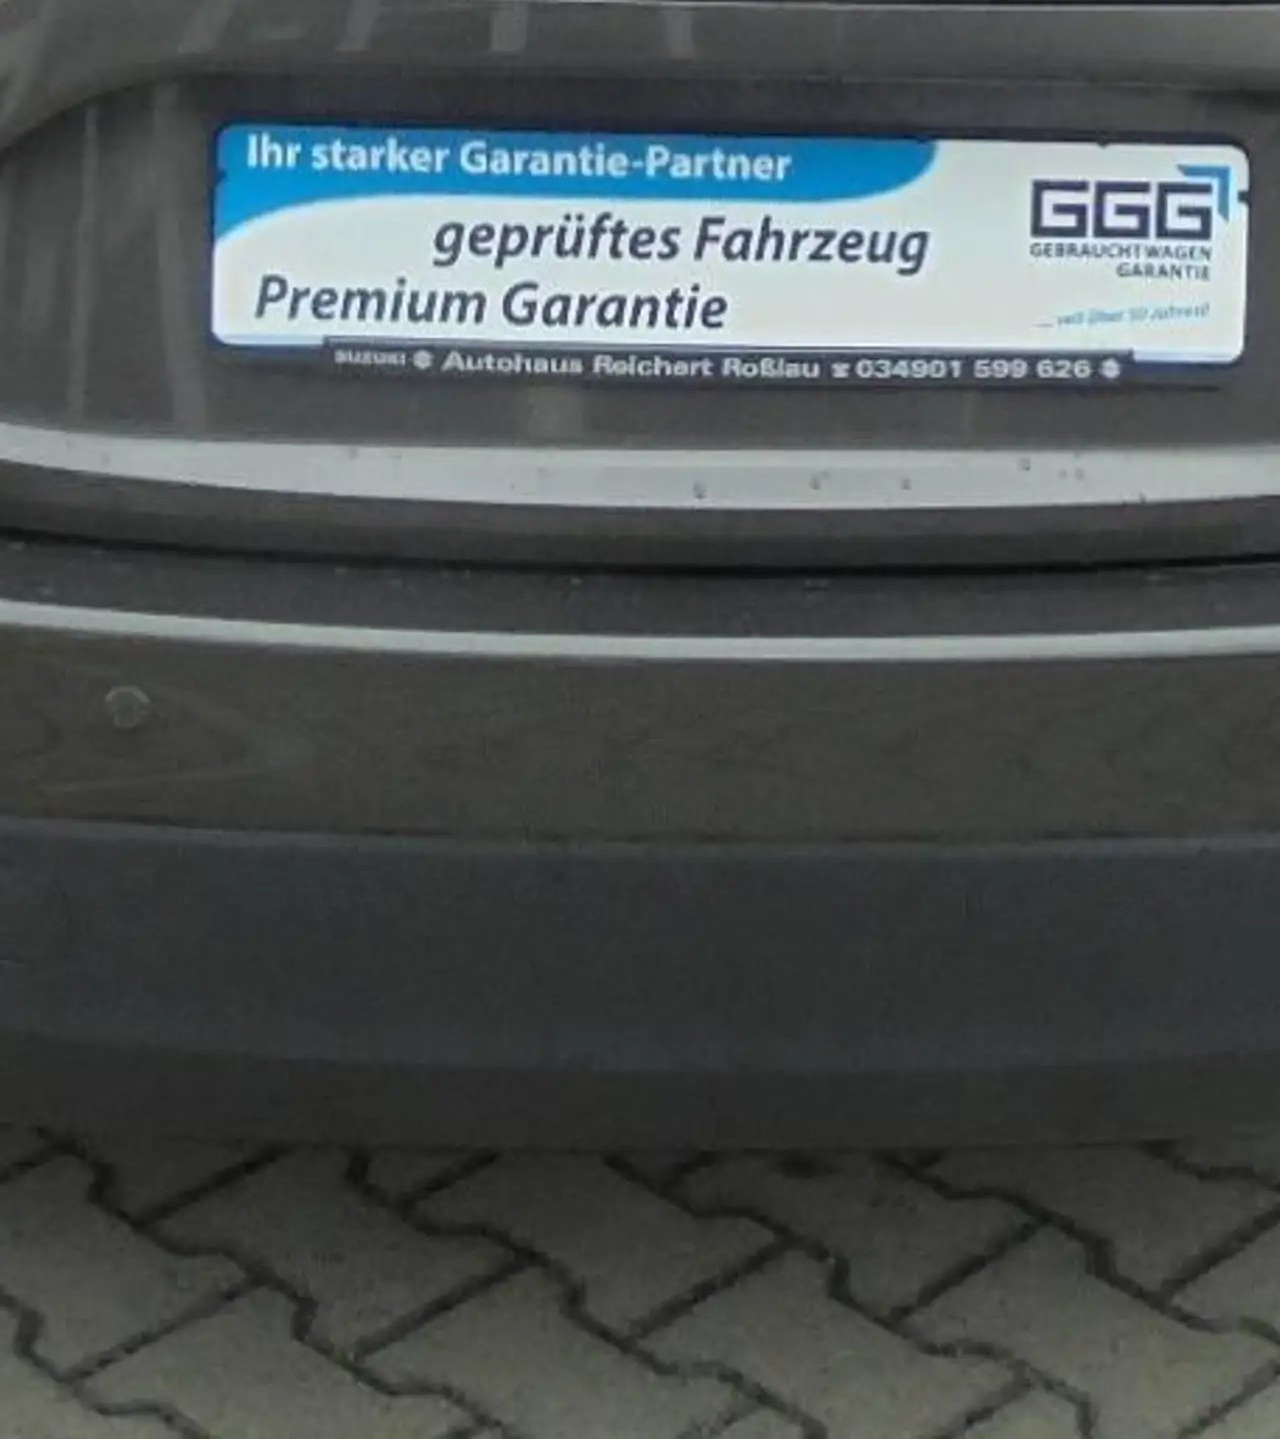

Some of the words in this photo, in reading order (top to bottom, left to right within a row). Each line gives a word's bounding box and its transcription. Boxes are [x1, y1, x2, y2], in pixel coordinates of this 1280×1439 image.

[246, 133, 301, 169] Ihr
[311, 136, 451, 174] starker
[459, 140, 792, 183] Garantie-Partner
[1029, 178, 1214, 241] GGG
[432, 211, 682, 268] geprüftes
[692, 215, 930, 277] Fahrzeug
[1115, 261, 1211, 283] GARANTIE
[253, 273, 488, 325] Premium
[501, 279, 729, 330] Garantie
[440, 348, 584, 374] Autohaus
[720, 357, 821, 380] Roßlau
[854, 358, 963, 381] 034901
[972, 358, 1029, 381] 599
[1036, 359, 1093, 381] 626
